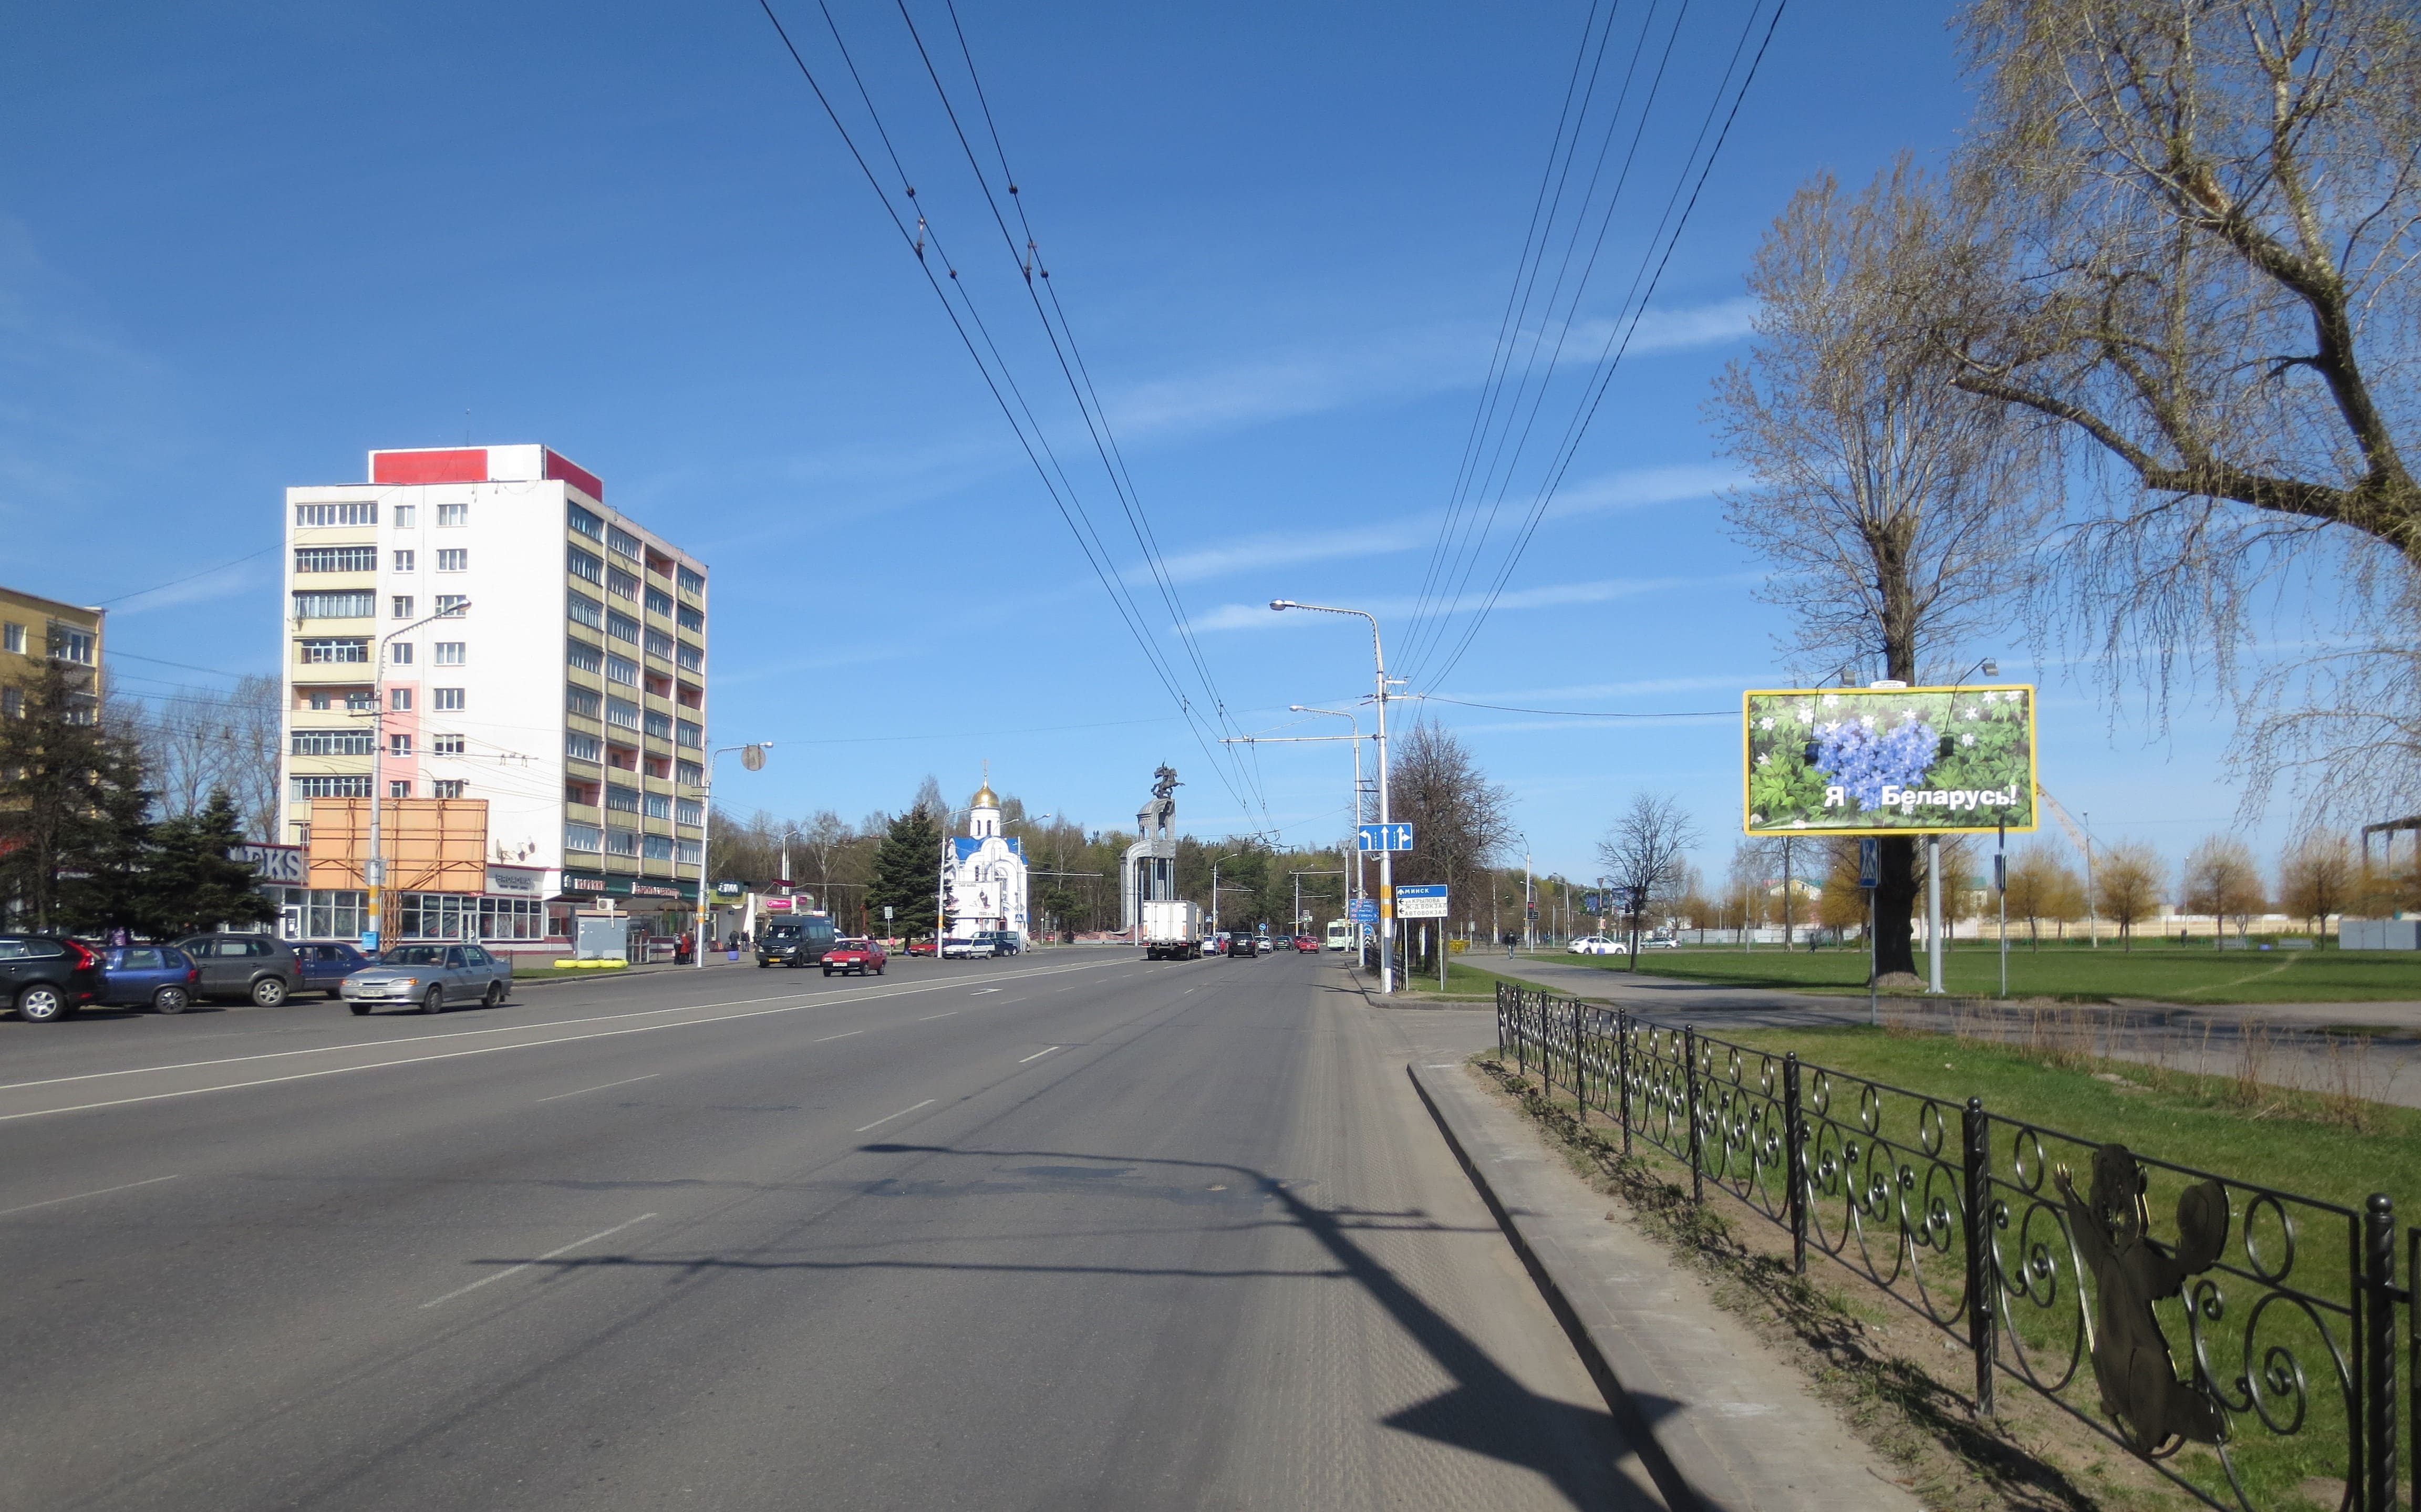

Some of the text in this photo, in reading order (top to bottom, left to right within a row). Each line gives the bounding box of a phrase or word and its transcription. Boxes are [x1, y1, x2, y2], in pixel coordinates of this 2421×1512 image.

[1824, 785, 2017, 810] Я Беларусь!
[495, 874, 532, 884] BROADWAY
